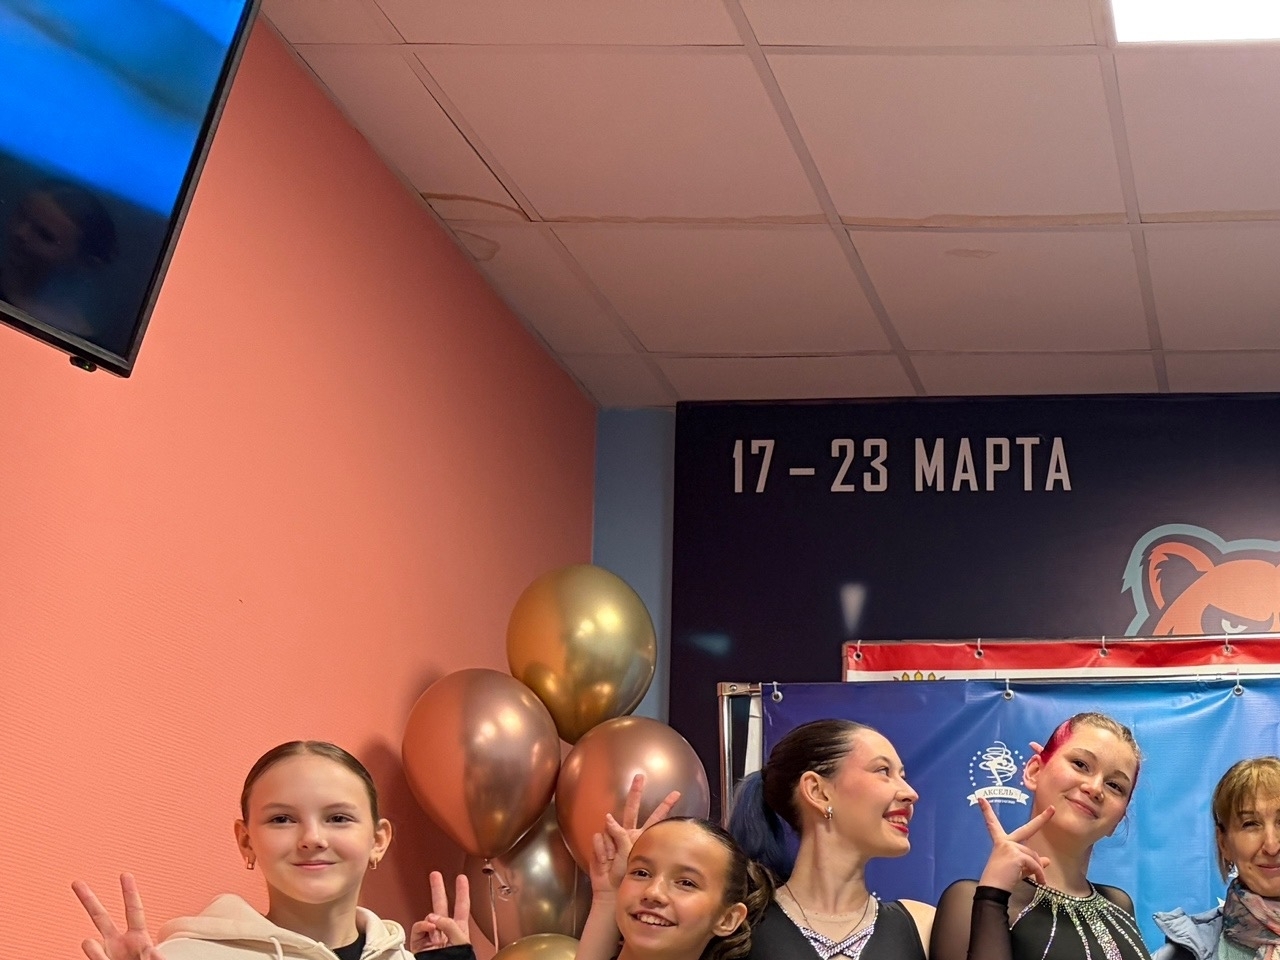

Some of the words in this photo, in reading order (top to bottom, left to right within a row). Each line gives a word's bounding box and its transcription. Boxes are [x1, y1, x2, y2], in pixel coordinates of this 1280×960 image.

[732, 439, 775, 493] 17
[830, 438, 888, 492] 23
[915, 437, 1072, 492] МАРТА
[983, 789, 1014, 797] АКСЕЛЬ
